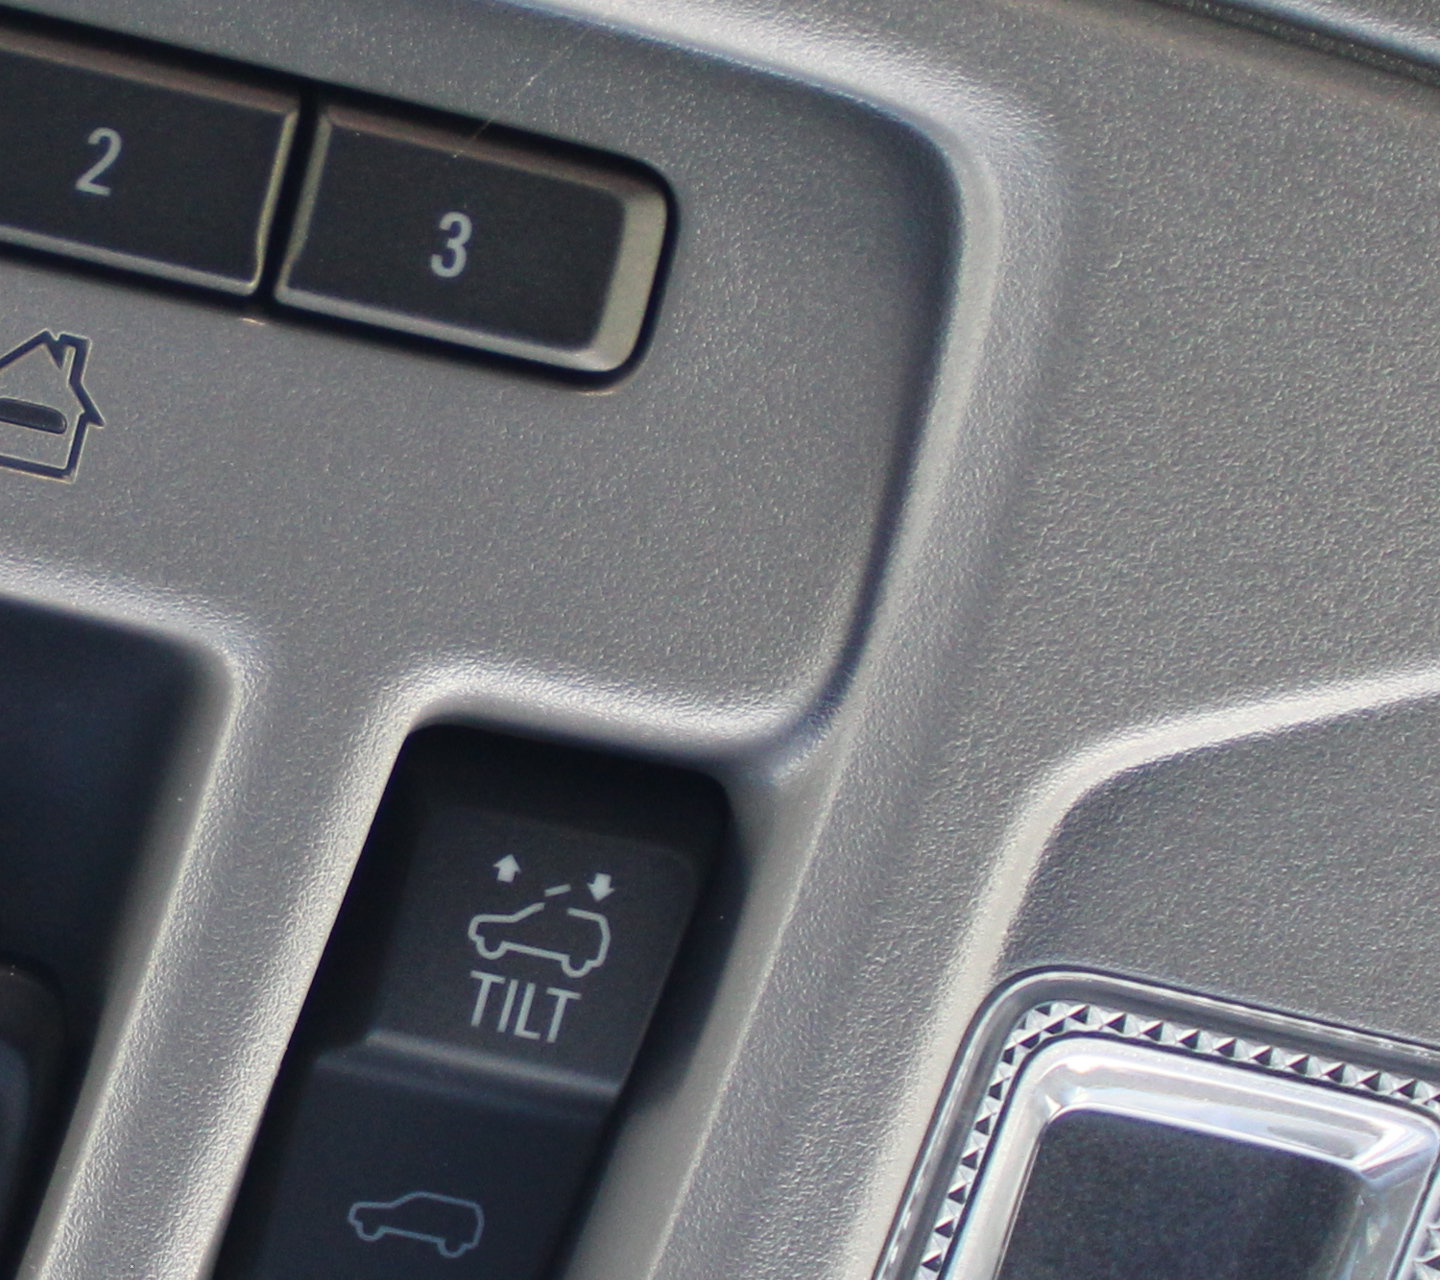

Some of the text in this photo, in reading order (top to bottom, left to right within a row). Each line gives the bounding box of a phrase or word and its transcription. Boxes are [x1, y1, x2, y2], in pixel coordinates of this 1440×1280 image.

[74, 127, 123, 197] 2
[429, 210, 474, 280] 3
[470, 970, 581, 1043] TILT
